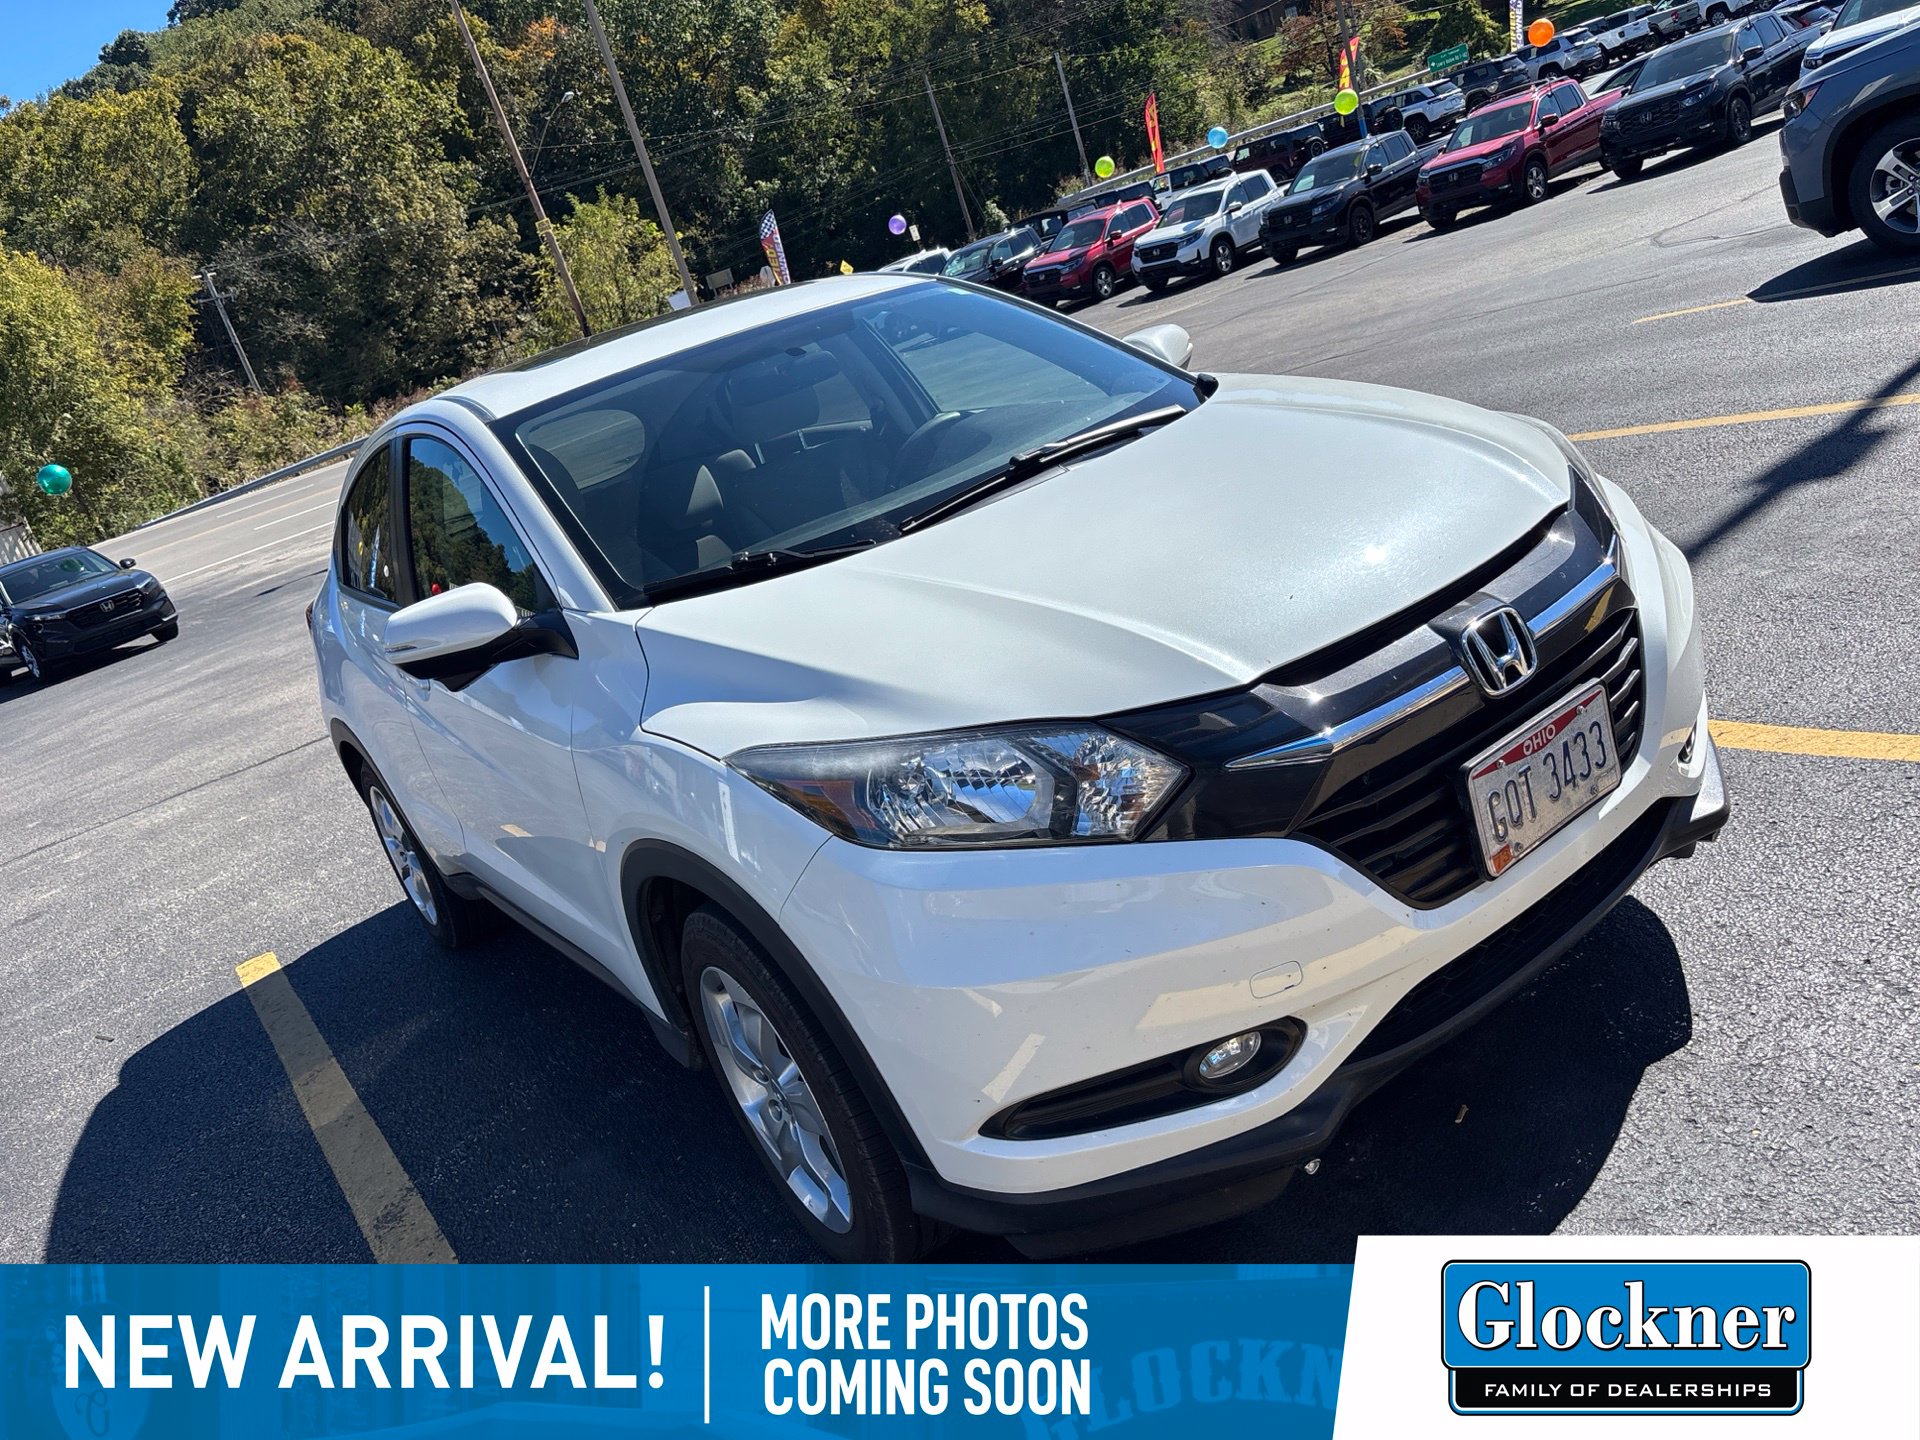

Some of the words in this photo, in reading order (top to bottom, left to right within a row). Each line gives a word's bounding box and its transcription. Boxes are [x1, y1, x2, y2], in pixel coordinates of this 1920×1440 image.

[1522, 724, 1556, 756] OHIO
[1488, 764, 1537, 843] GQT
[1542, 720, 1607, 802] 3433
